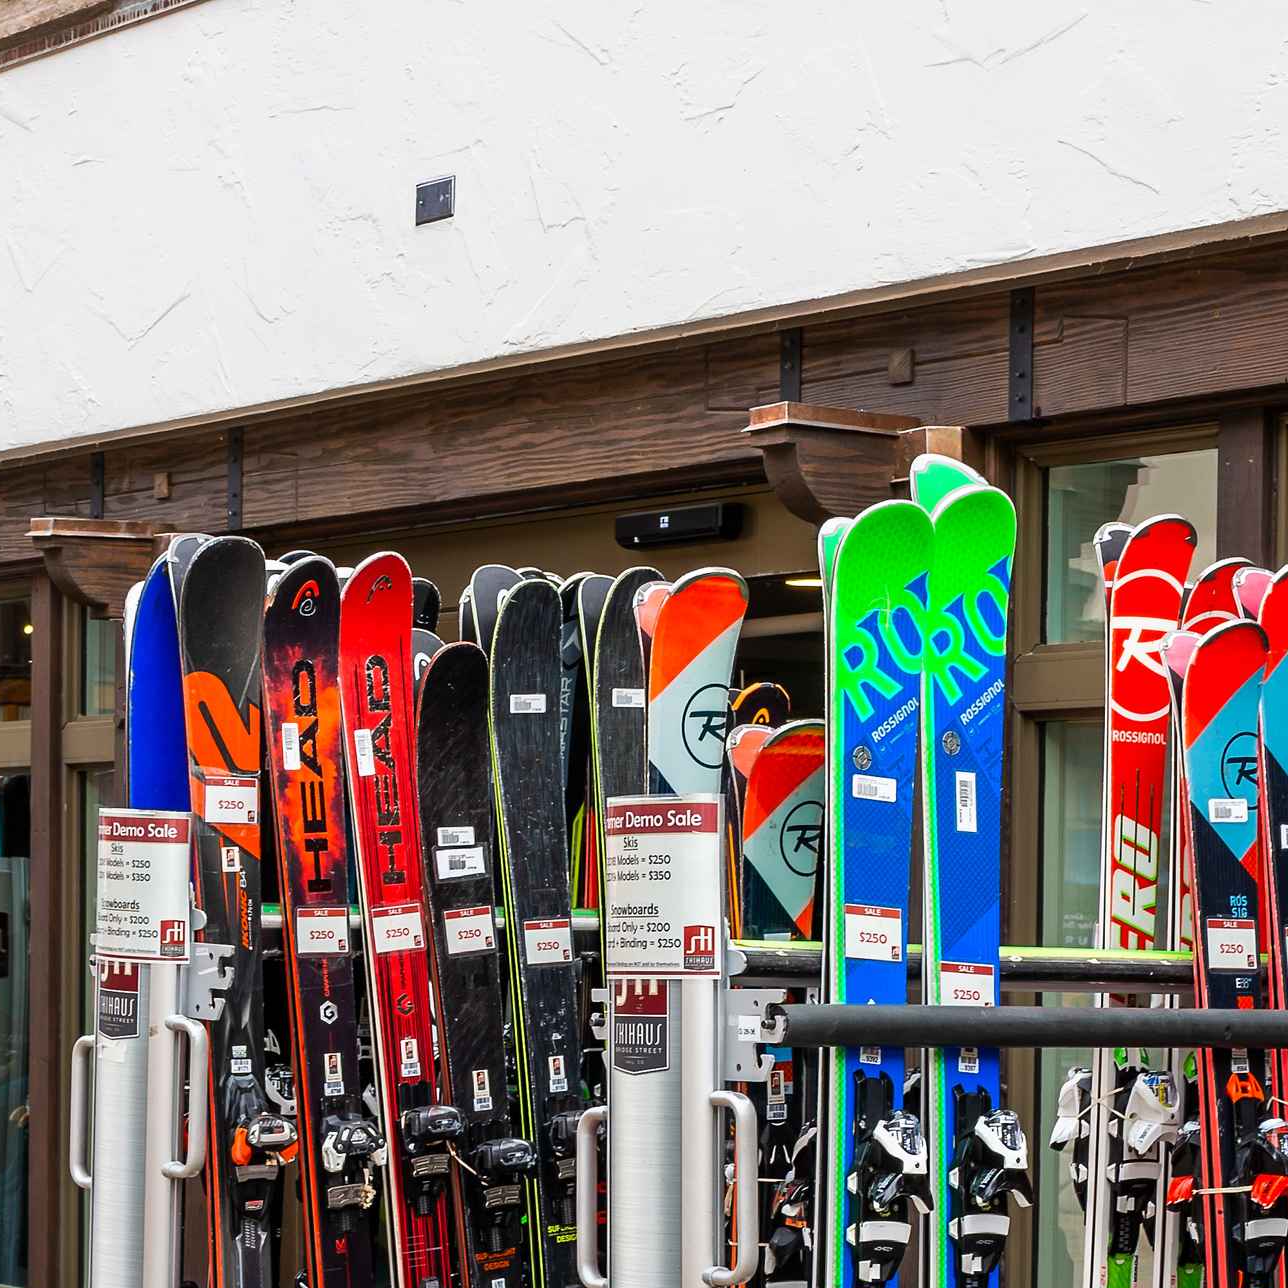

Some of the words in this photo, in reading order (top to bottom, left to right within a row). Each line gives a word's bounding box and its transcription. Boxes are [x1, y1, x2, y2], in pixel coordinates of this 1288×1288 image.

[1112, 729, 1168, 746] ROSSIGNOL
[292, 657, 333, 893] HEAD
[365, 654, 406, 885] HEAD
[217, 799, 245, 810] $250
[625, 810, 663, 828] Demo
[667, 809, 702, 827] Sale
[112, 822, 145, 837] Demo
[147, 823, 178, 838] Sale
[111, 843, 124, 853] Skis
[623, 836, 639, 849] Skis
[131, 859, 151, 869] $250
[617, 854, 640, 866] Models
[648, 854, 671, 865] $250
[131, 873, 151, 882] $350
[617, 870, 640, 882] Models
[648, 870, 672, 881] $350
[1229, 895, 1248, 907] ROS
[313, 909, 329, 917] SALE
[610, 902, 659, 916] Snowboards
[863, 907, 882, 916] SALE
[1231, 907, 1248, 918] SIG
[129, 915, 150, 925] $200
[239, 889, 249, 949] IKONIC
[385, 927, 410, 939] $250
[621, 921, 639, 935] Only
[646, 922, 671, 933] $200
[138, 929, 159, 939] $250
[309, 930, 335, 940] $250
[457, 929, 482, 940] $250
[858, 931, 888, 944] $250
[536, 941, 560, 951] $250
[657, 938, 682, 949] $250
[1219, 943, 1244, 954] $250
[957, 965, 975, 974] SALE
[953, 988, 981, 1001] $250
[615, 1022, 663, 1046] SKIHAUS
[634, 1046, 662, 1054] STREET
